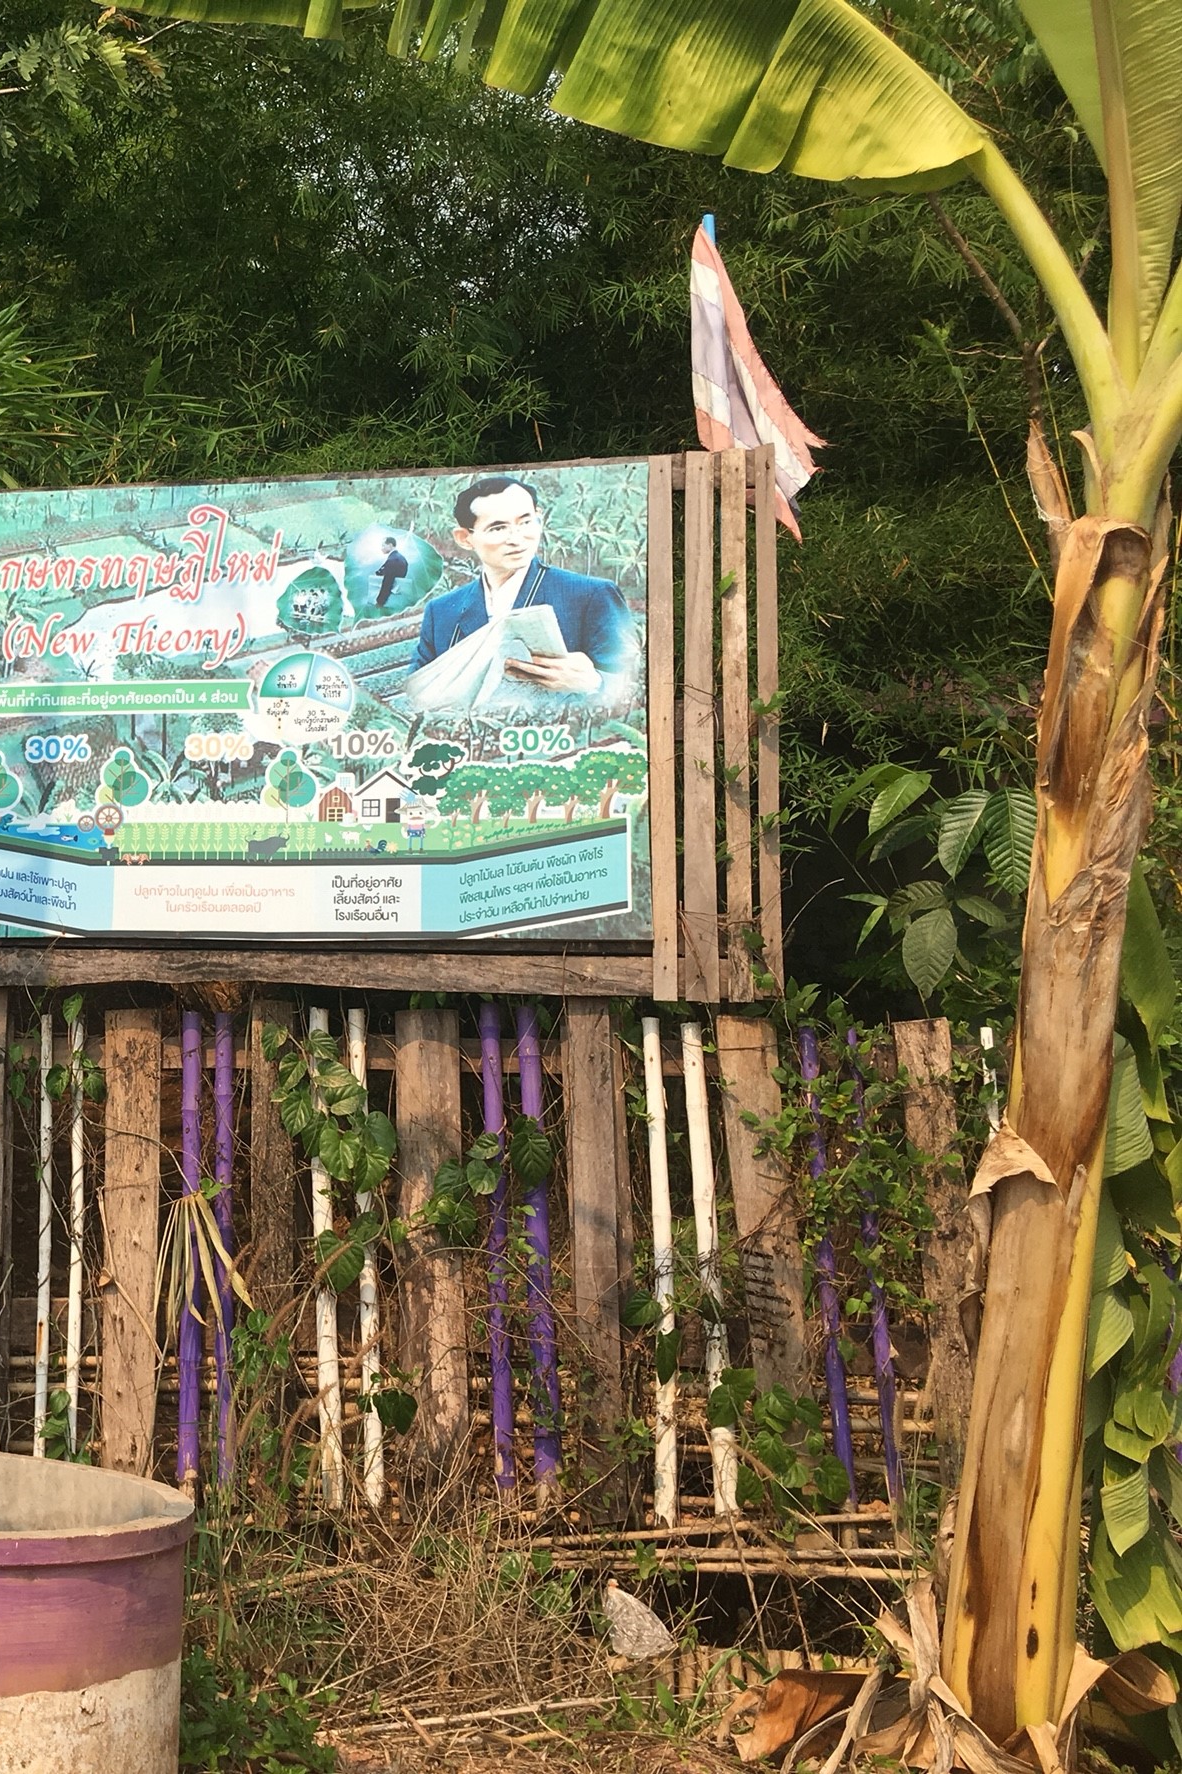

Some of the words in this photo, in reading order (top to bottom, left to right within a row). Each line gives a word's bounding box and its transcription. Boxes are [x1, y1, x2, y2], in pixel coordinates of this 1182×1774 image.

[2, 614, 94, 661] (New
[111, 612, 247, 669] Theory)
[198, 691, 207, 703] 4
[210, 689, 238, 704] ส่วน
[27, 736, 89, 761] 30%
[186, 735, 250, 759] 30%
[331, 733, 395, 757] 10%
[502, 727, 571, 753] 30%
[332, 874, 403, 891] เป็นที่อยู่อาศัย
[333, 890, 380, 904] เลี้ยงสัตว์
[383, 894, 400, 904] และ
